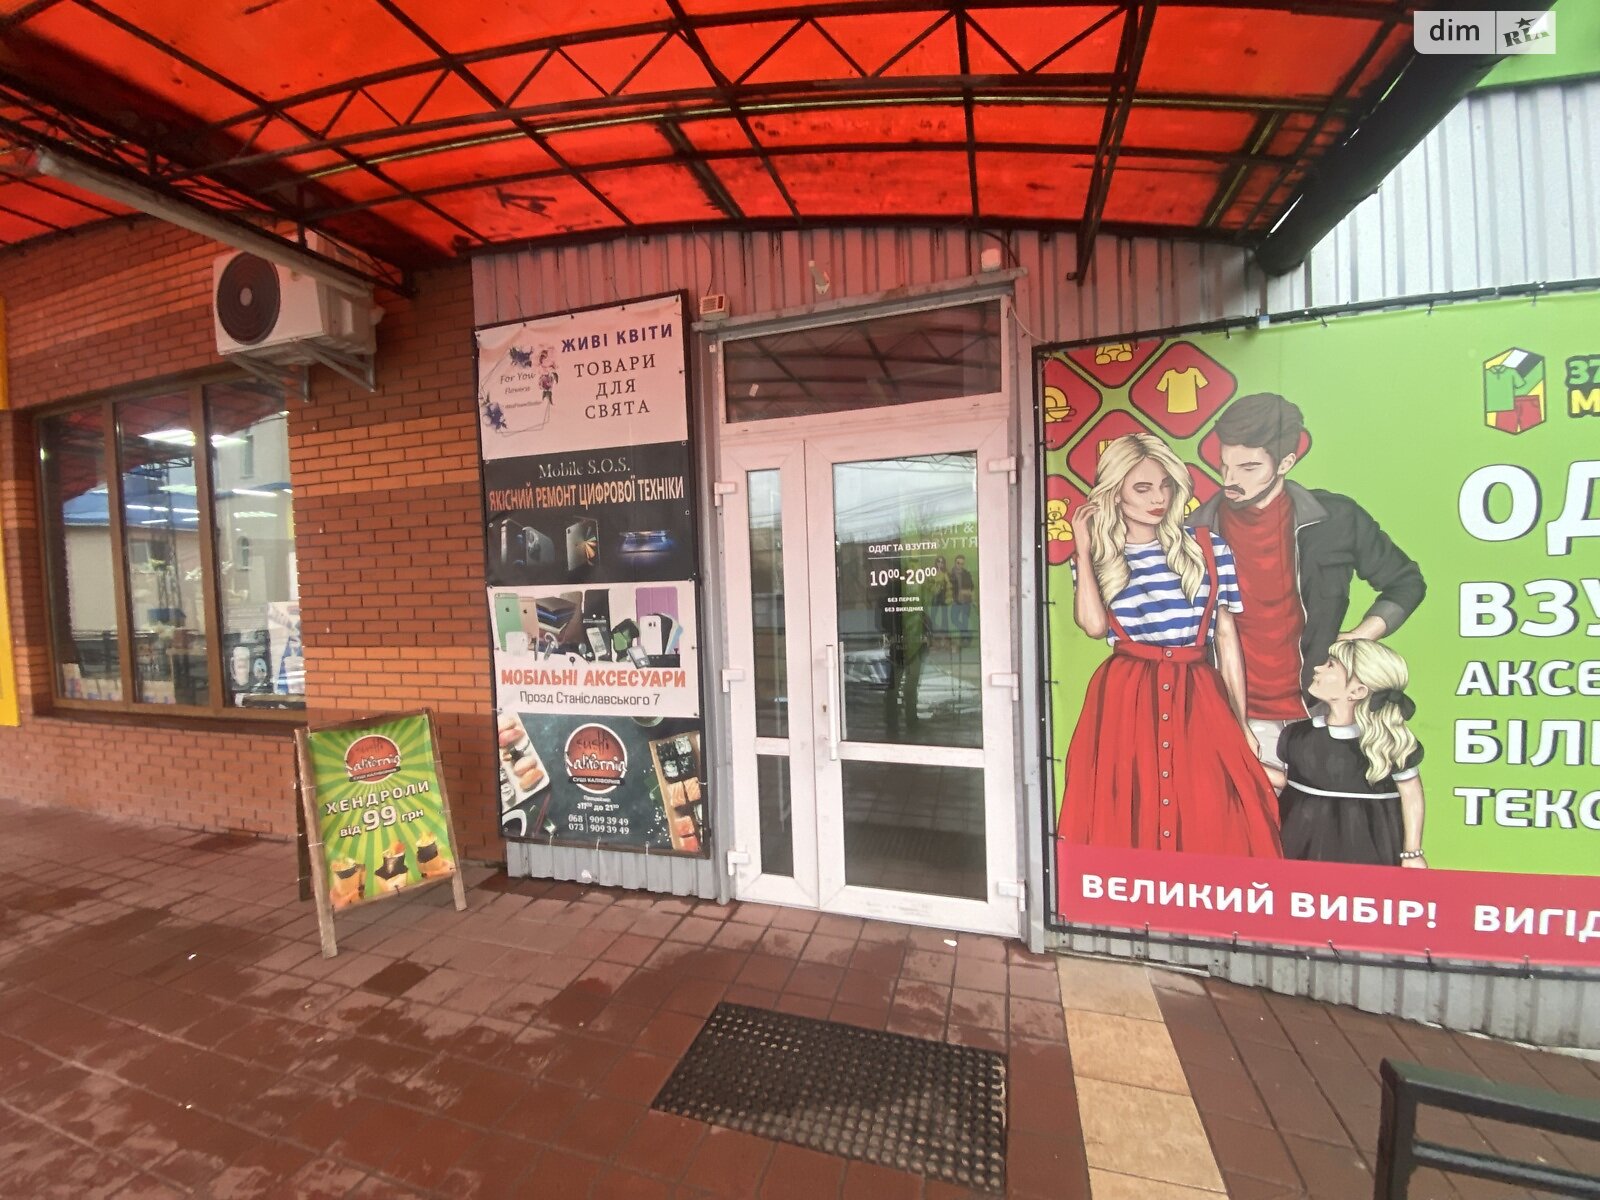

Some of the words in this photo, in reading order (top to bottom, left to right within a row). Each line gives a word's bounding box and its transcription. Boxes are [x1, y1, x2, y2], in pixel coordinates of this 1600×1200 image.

[561, 334, 608, 353] ЖИВІ
[616, 323, 673, 345] КВІТИ
[574, 353, 656, 378] ТОВАРИ
[595, 379, 636, 400] ДЛЯ
[585, 400, 650, 419] СВЯТА
[538, 461, 584, 479] Mobile
[587, 457, 631, 475] S.O.S.
[489, 483, 535, 511] ЯКІСНИЙ
[537, 484, 577, 509] РЕМОНТ
[579, 475, 636, 510] ЦИФРОВОЇ
[637, 475, 684, 500] ТЕХНІКИ
[868, 545, 892, 554] ОДЯГ
[893, 544, 904, 552] ТА
[905, 542, 937, 551] ВЗУТТЯ
[501, 669, 578, 687] МОБІЛЬНІ
[583, 670, 686, 688] АКСЕСУАРИ
[520, 690, 554, 705] Прозд
[556, 692, 650, 706] Станіславського
[653, 693, 661, 705] 7
[325, 780, 430, 815] ХЕНДРОЛИ
[340, 825, 362, 838] від
[363, 805, 398, 832] 99
[401, 808, 425, 824] грн
[568, 823, 584, 831] 073
[589, 824, 605, 833] 909
[606, 826, 617, 834] 39
[619, 827, 630, 835] 49
[589, 815, 605, 824] 909
[606, 817, 617, 825] 39
[618, 818, 629, 826] 49
[1082, 874, 1275, 915] ВЕЛИКИЙ
[1290, 891, 1438, 929] ВИБІР!
